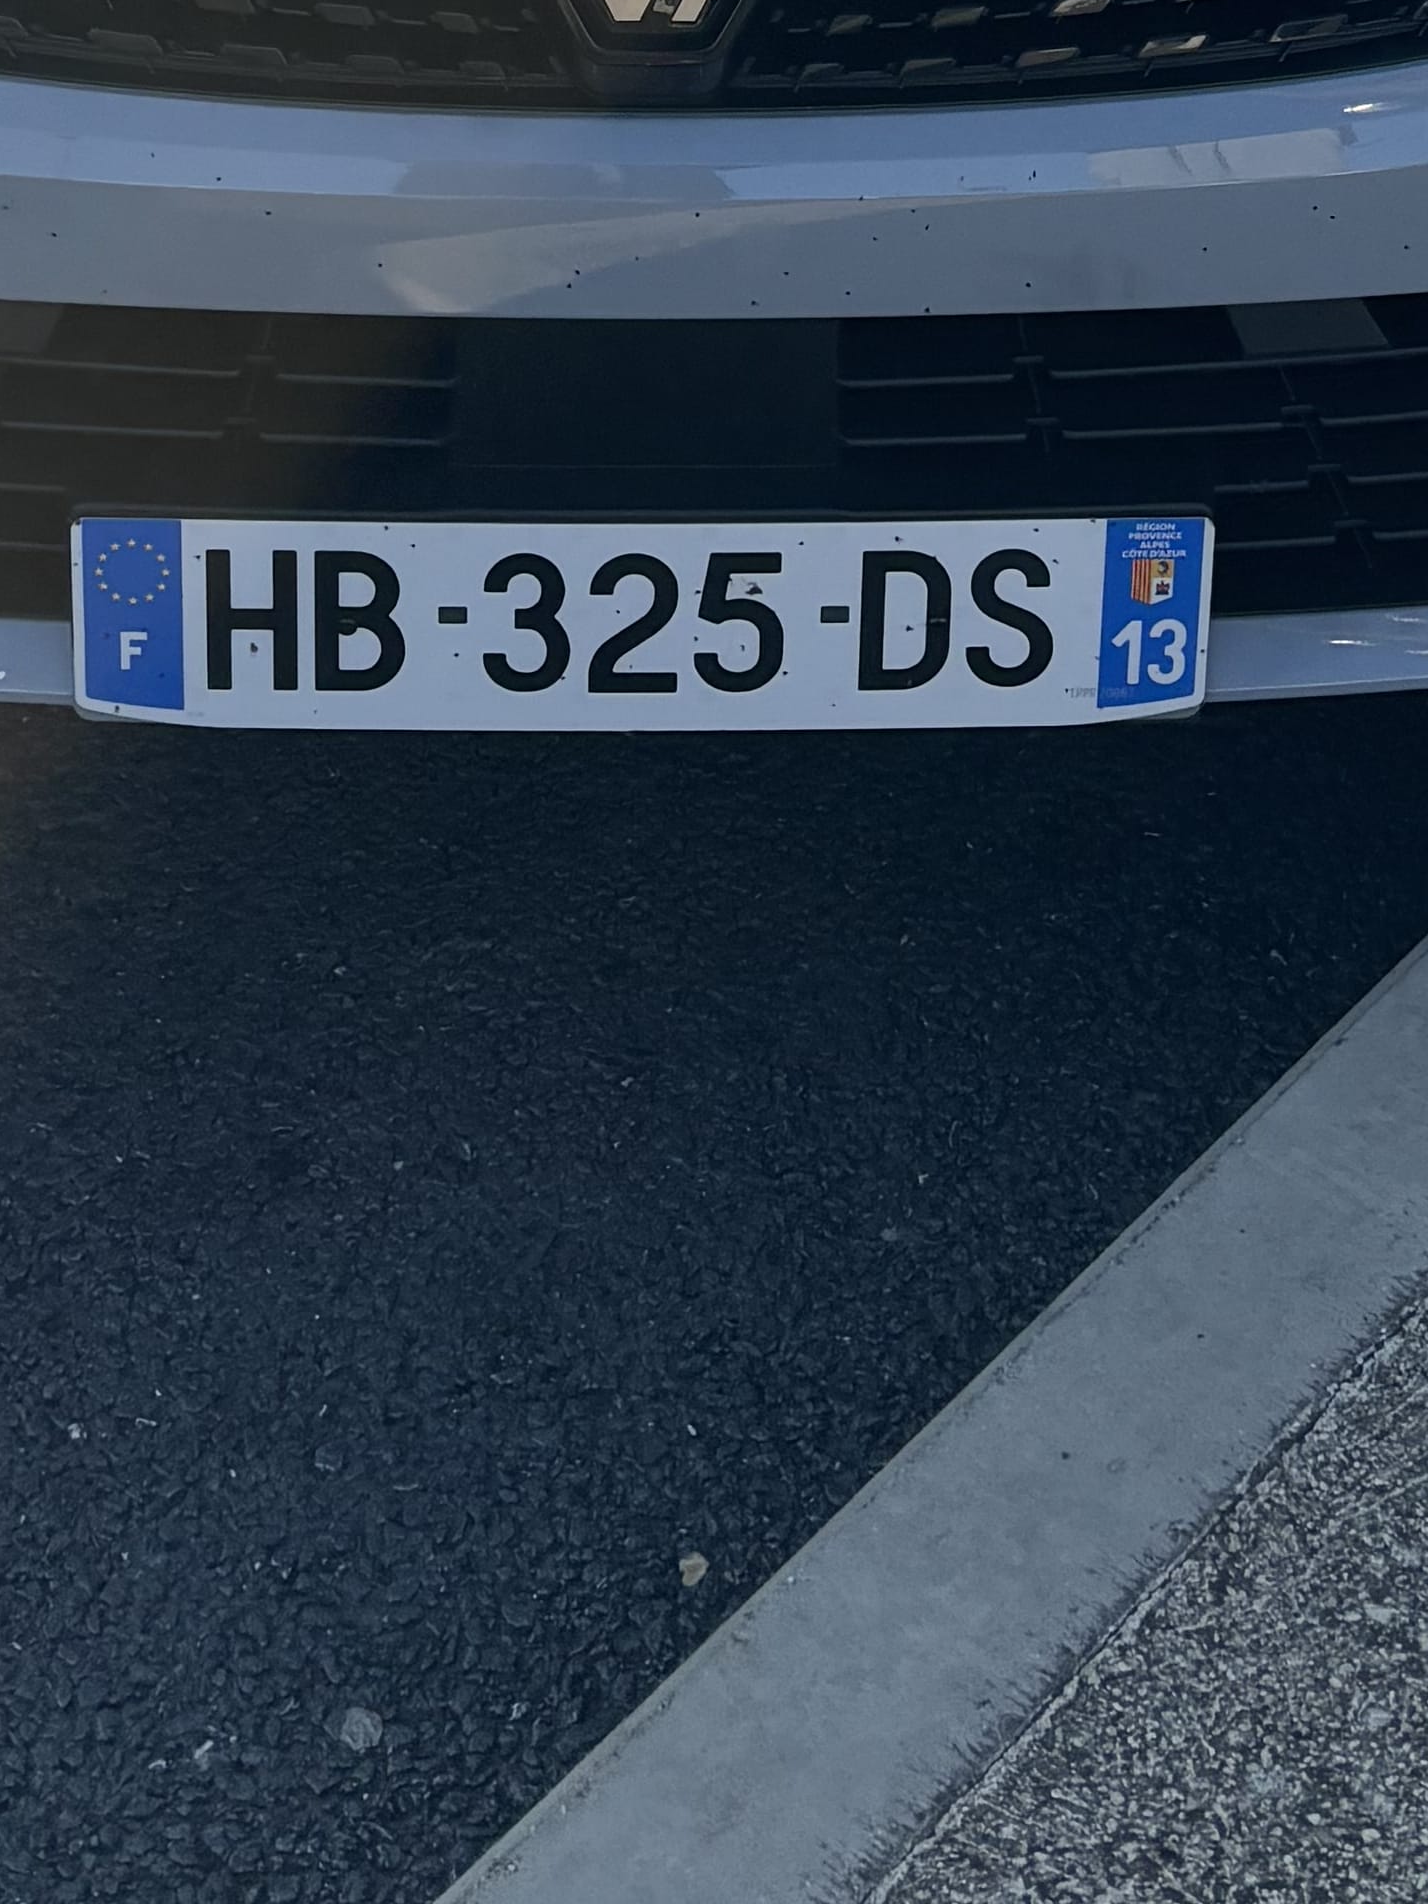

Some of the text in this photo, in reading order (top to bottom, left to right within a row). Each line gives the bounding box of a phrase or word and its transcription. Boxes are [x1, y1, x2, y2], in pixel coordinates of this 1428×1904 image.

[1128, 531, 1182, 540] PROVENCE
[1140, 541, 1170, 549] ALPES
[205, 547, 1054, 694] HB-325-DS
[119, 632, 148, 670] F
[1111, 618, 1187, 685] 13
